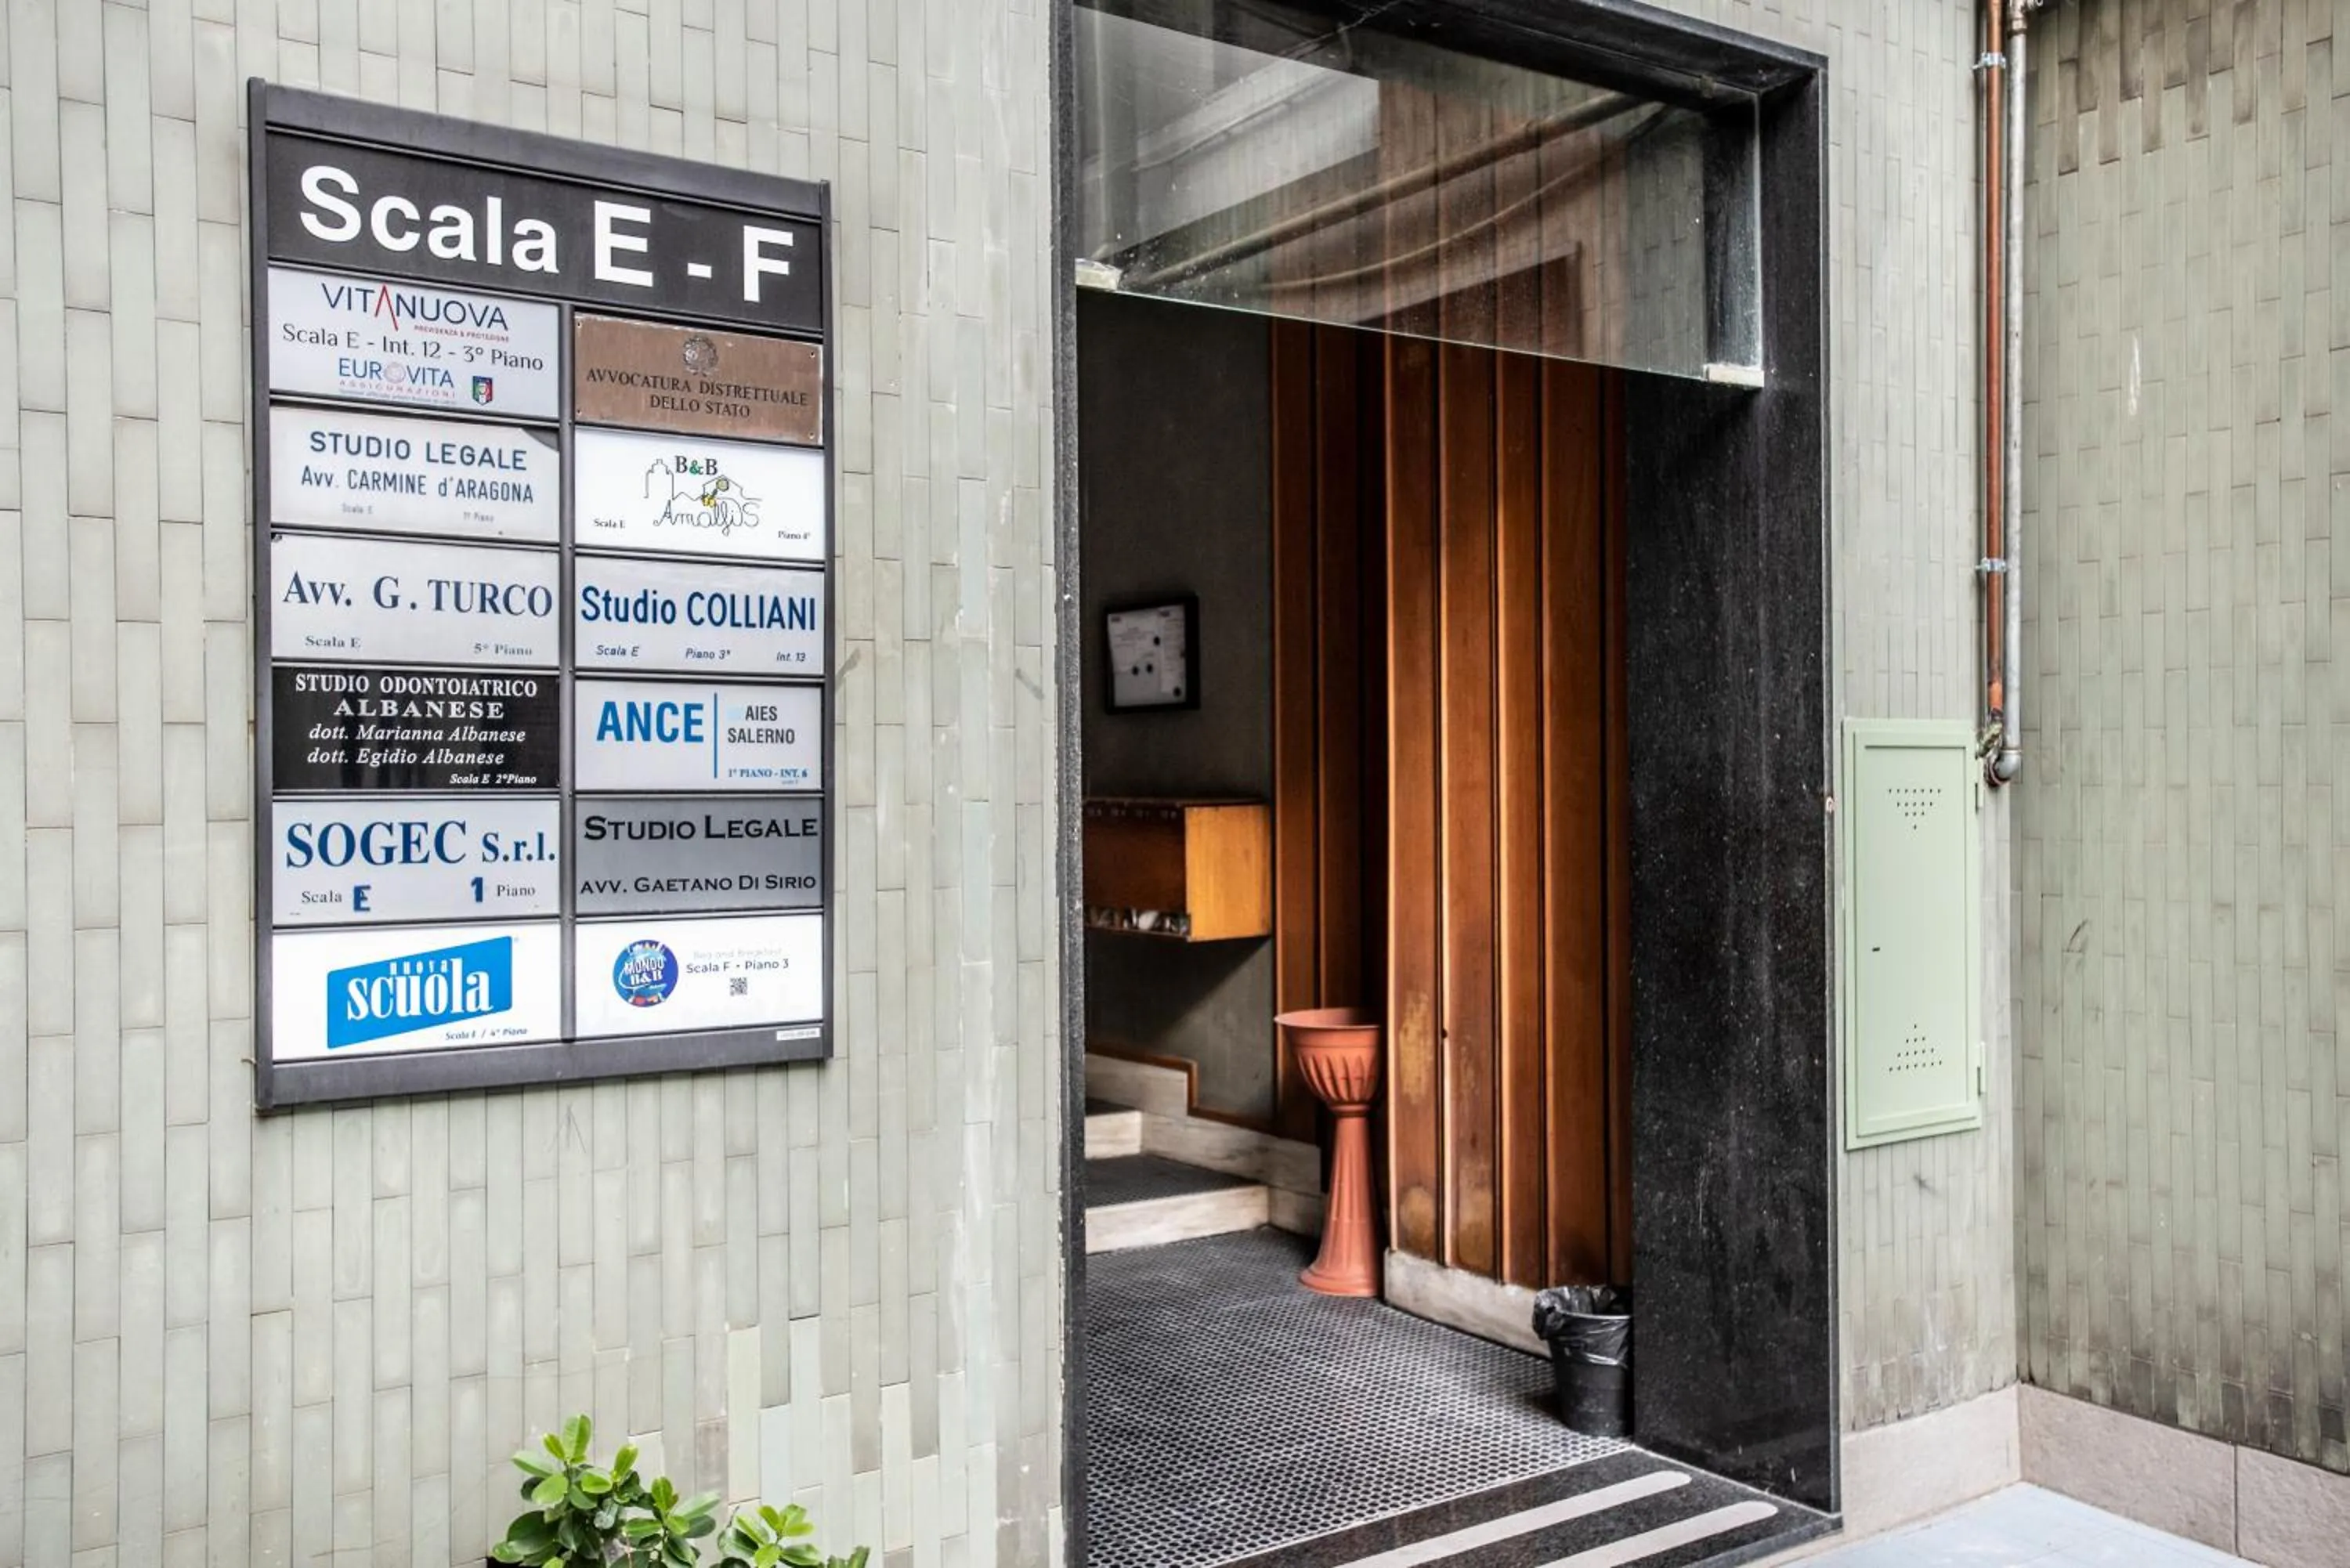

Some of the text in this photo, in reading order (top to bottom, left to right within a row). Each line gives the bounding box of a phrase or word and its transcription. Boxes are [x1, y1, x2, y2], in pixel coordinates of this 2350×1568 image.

[301, 165, 559, 273] Scala
[595, 200, 653, 287] E
[743, 225, 794, 302] F
[322, 283, 508, 331] VITANUOVA
[283, 323, 338, 348] Scala
[346, 332, 360, 349] E
[383, 336, 414, 356] Int.
[423, 341, 441, 358] 12
[491, 349, 544, 371] Piano
[587, 367, 808, 406] AVVOCATURA DISTRETTUALE
[649, 394, 750, 418] DELLO STATO
[310, 430, 527, 471] STUDIO LEGALE
[674, 455, 718, 475] B&B
[301, 465, 533, 504] Avv. CARMINE d'ARAGONA
[593, 517, 616, 529] Scala
[778, 530, 801, 540] Piano
[283, 570, 352, 607] Avv.
[428, 579, 552, 617] TURCO
[581, 585, 815, 630] Studio COLLIANI
[305, 635, 345, 649] Scala
[350, 637, 361, 649] E
[494, 644, 533, 656] Piano
[595, 645, 627, 656] Scala
[631, 646, 639, 656] E
[685, 648, 715, 659] Piano
[295, 673, 537, 697] STUDIO ODONTOIATRICO
[333, 699, 504, 719] ALBANESE
[745, 706, 778, 721] AIES
[309, 723, 526, 742] dott. Marianna Albanese
[596, 701, 704, 743] ANCE
[727, 728, 795, 744] SALERNO
[307, 747, 504, 767] dott. Egidio Albanese
[450, 773, 479, 784] Scala
[481, 774, 490, 784] E
[739, 768, 772, 779] PIANO
[584, 815, 818, 840] STUDIO LEGALE
[287, 820, 556, 869] SOGEC S.r.l.
[301, 877, 536, 912] Scala E 1 Piano
[580, 880, 627, 894] AVV.
[634, 877, 732, 892] GAETANO
[765, 875, 816, 891] SIRIO
[624, 956, 665, 975] MONDO
[686, 961, 720, 974] Scala
[723, 960, 730, 971] F
[745, 959, 779, 970] Piano
[783, 959, 790, 969] 3
[346, 957, 494, 1021] scuola
